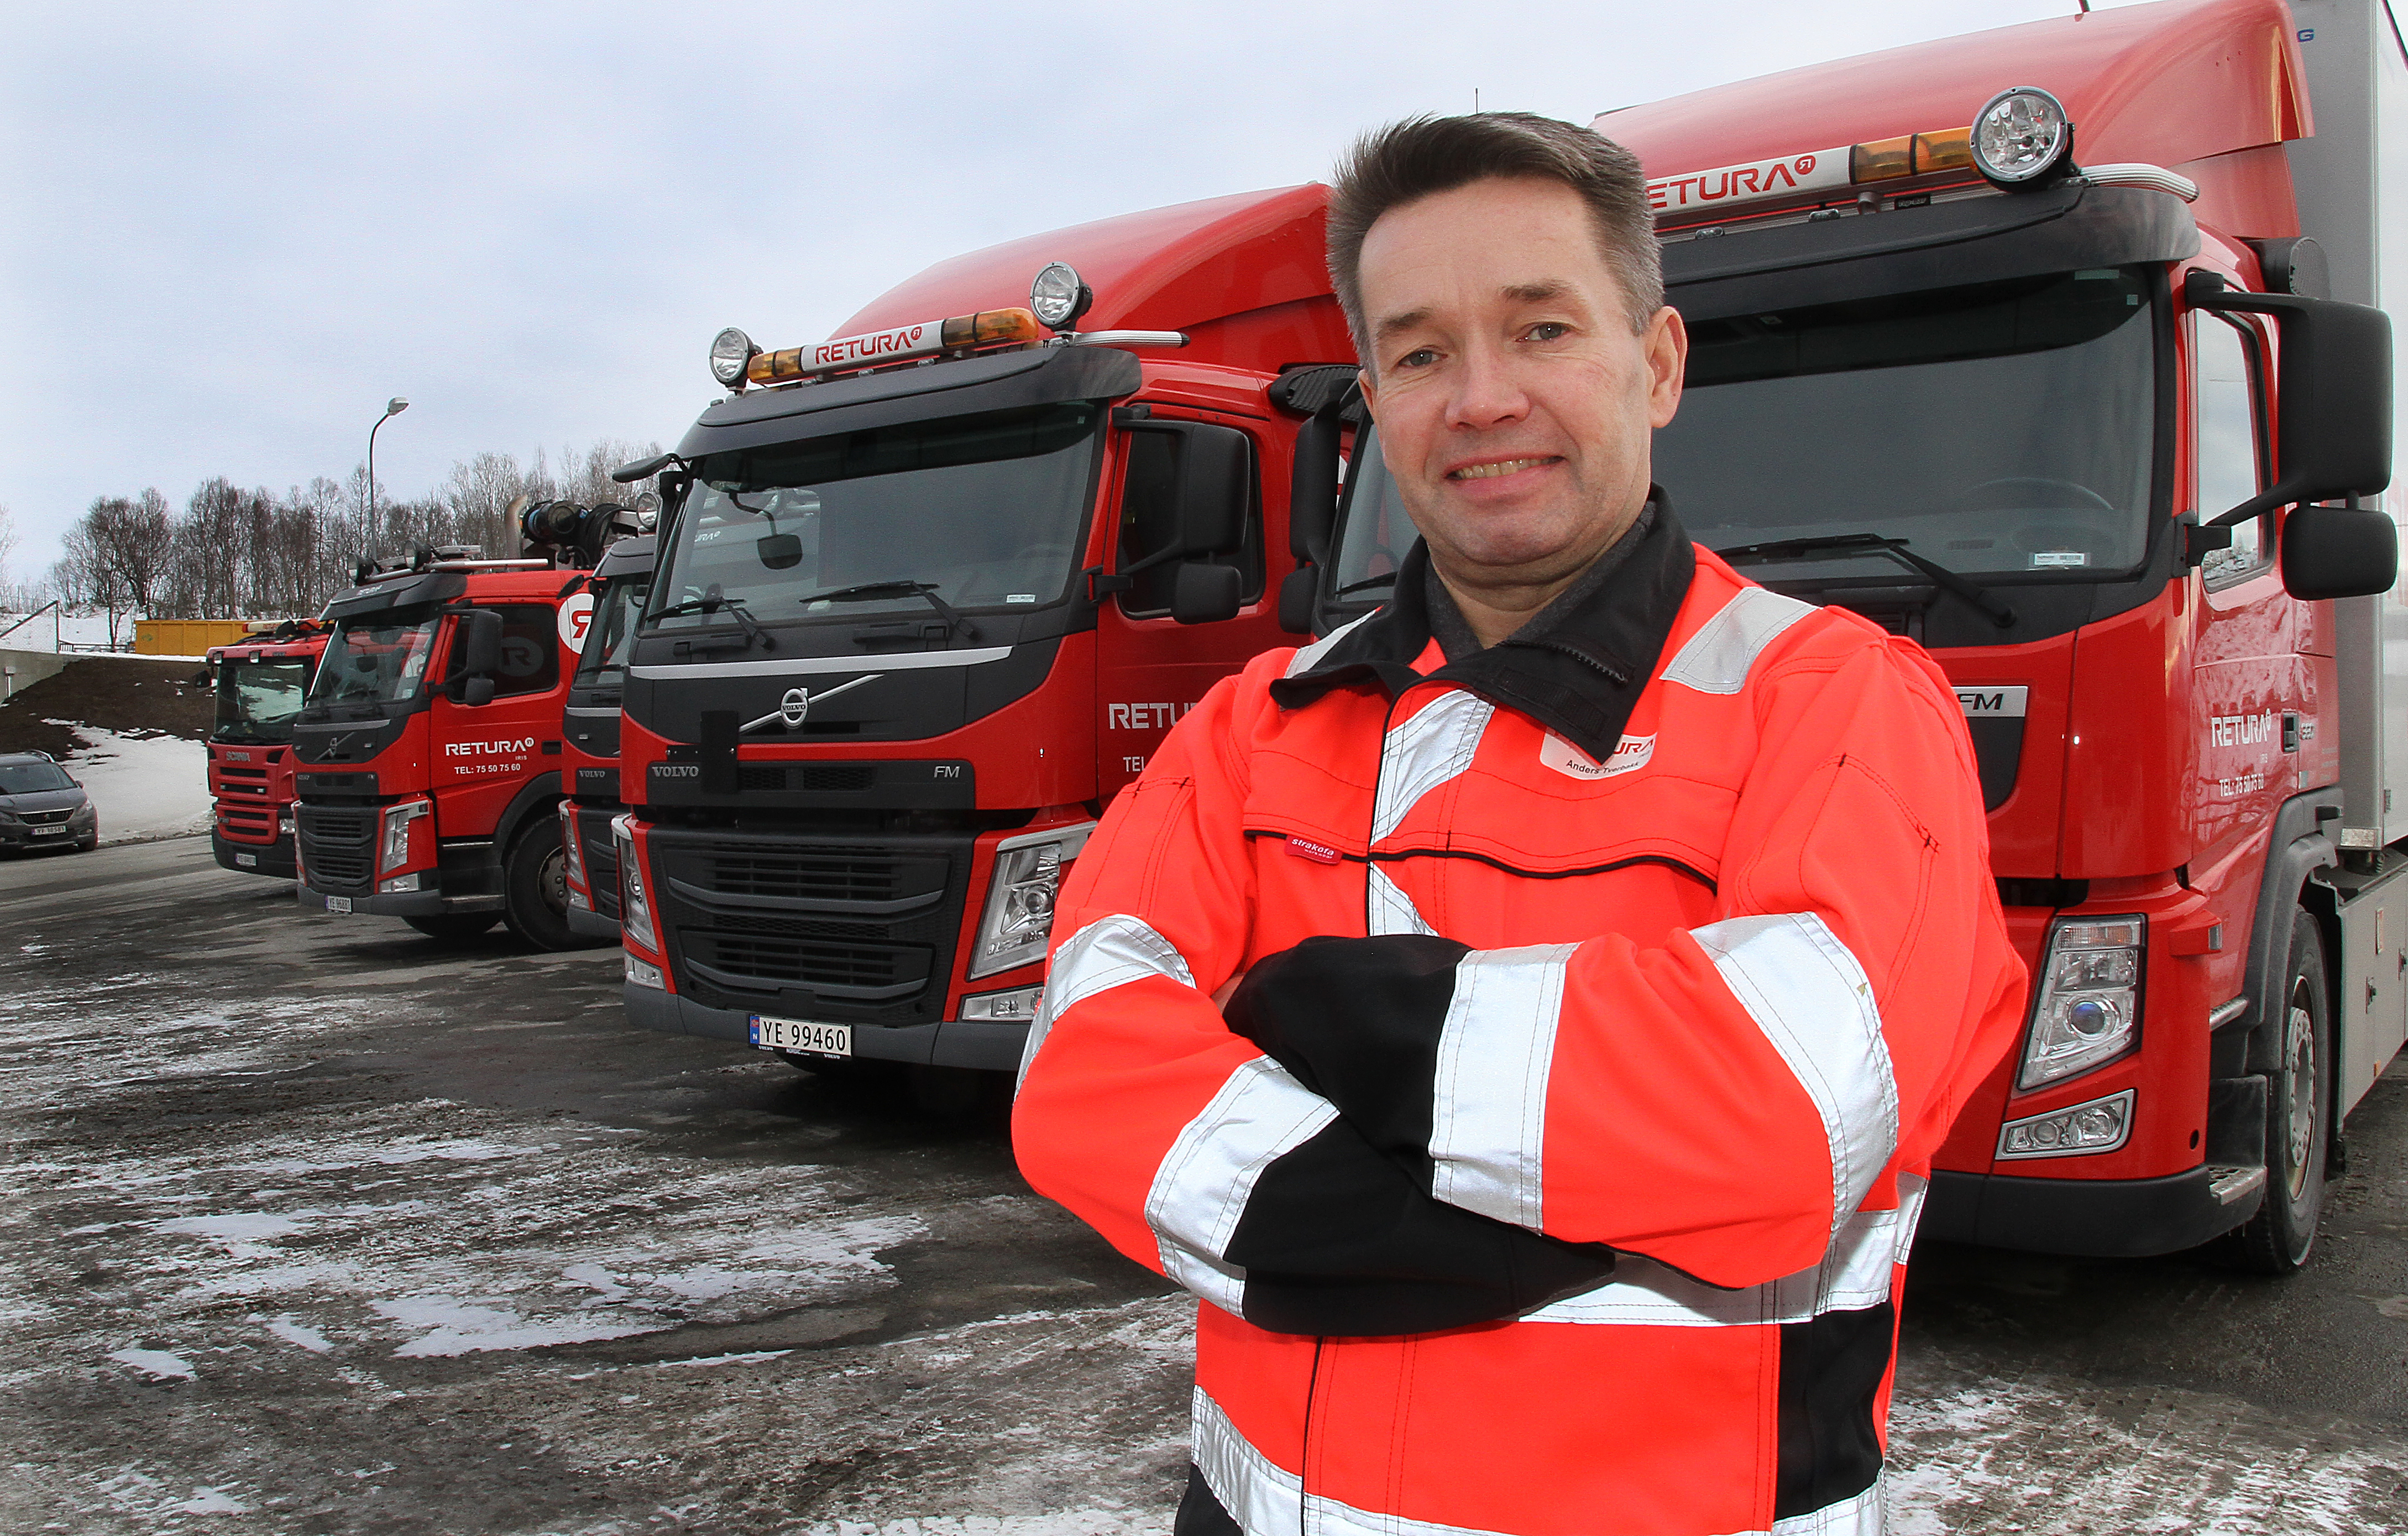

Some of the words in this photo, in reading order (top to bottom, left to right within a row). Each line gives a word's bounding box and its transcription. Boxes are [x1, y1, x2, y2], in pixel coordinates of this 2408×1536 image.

[815, 331, 913, 364] RETURA
[1109, 703, 1198, 729] RETU
[2211, 714, 2267, 748] RETURA
[446, 740, 527, 756] RETURA
[652, 766, 699, 777] VOLVO
[934, 766, 960, 778] FM
[1566, 760, 1600, 774] Anders
[763, 1021, 783, 1044] YE
[791, 1025, 846, 1051] 99460
